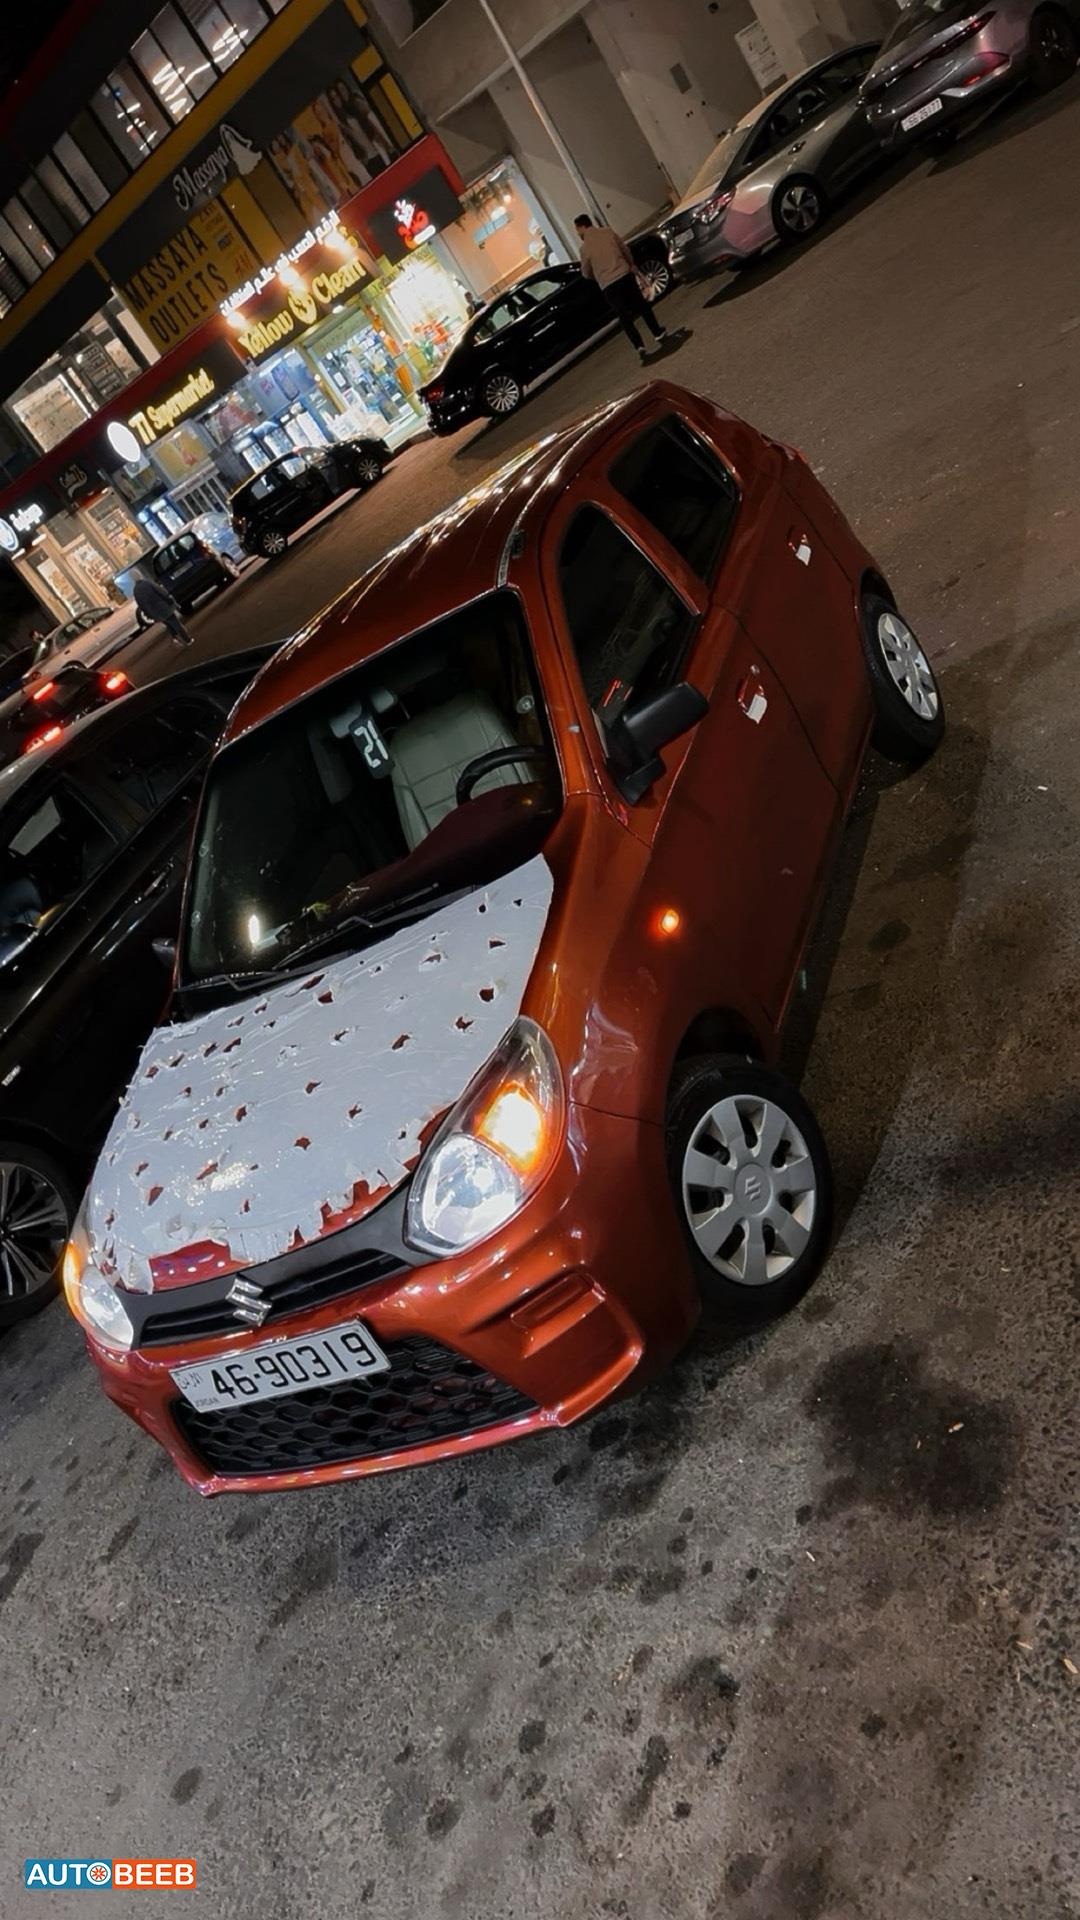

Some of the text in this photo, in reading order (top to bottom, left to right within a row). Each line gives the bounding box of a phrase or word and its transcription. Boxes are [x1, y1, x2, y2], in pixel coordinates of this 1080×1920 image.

[173, 146, 229, 211] Massaya
[124, 225, 208, 312] MASSAYA
[150, 263, 228, 343] OUTLETS
[237, 309, 294, 358] Yellow
[312, 258, 366, 304] Clean
[146, 367, 215, 430] Supermarket
[211, 1332, 377, 1399] 46-90319
